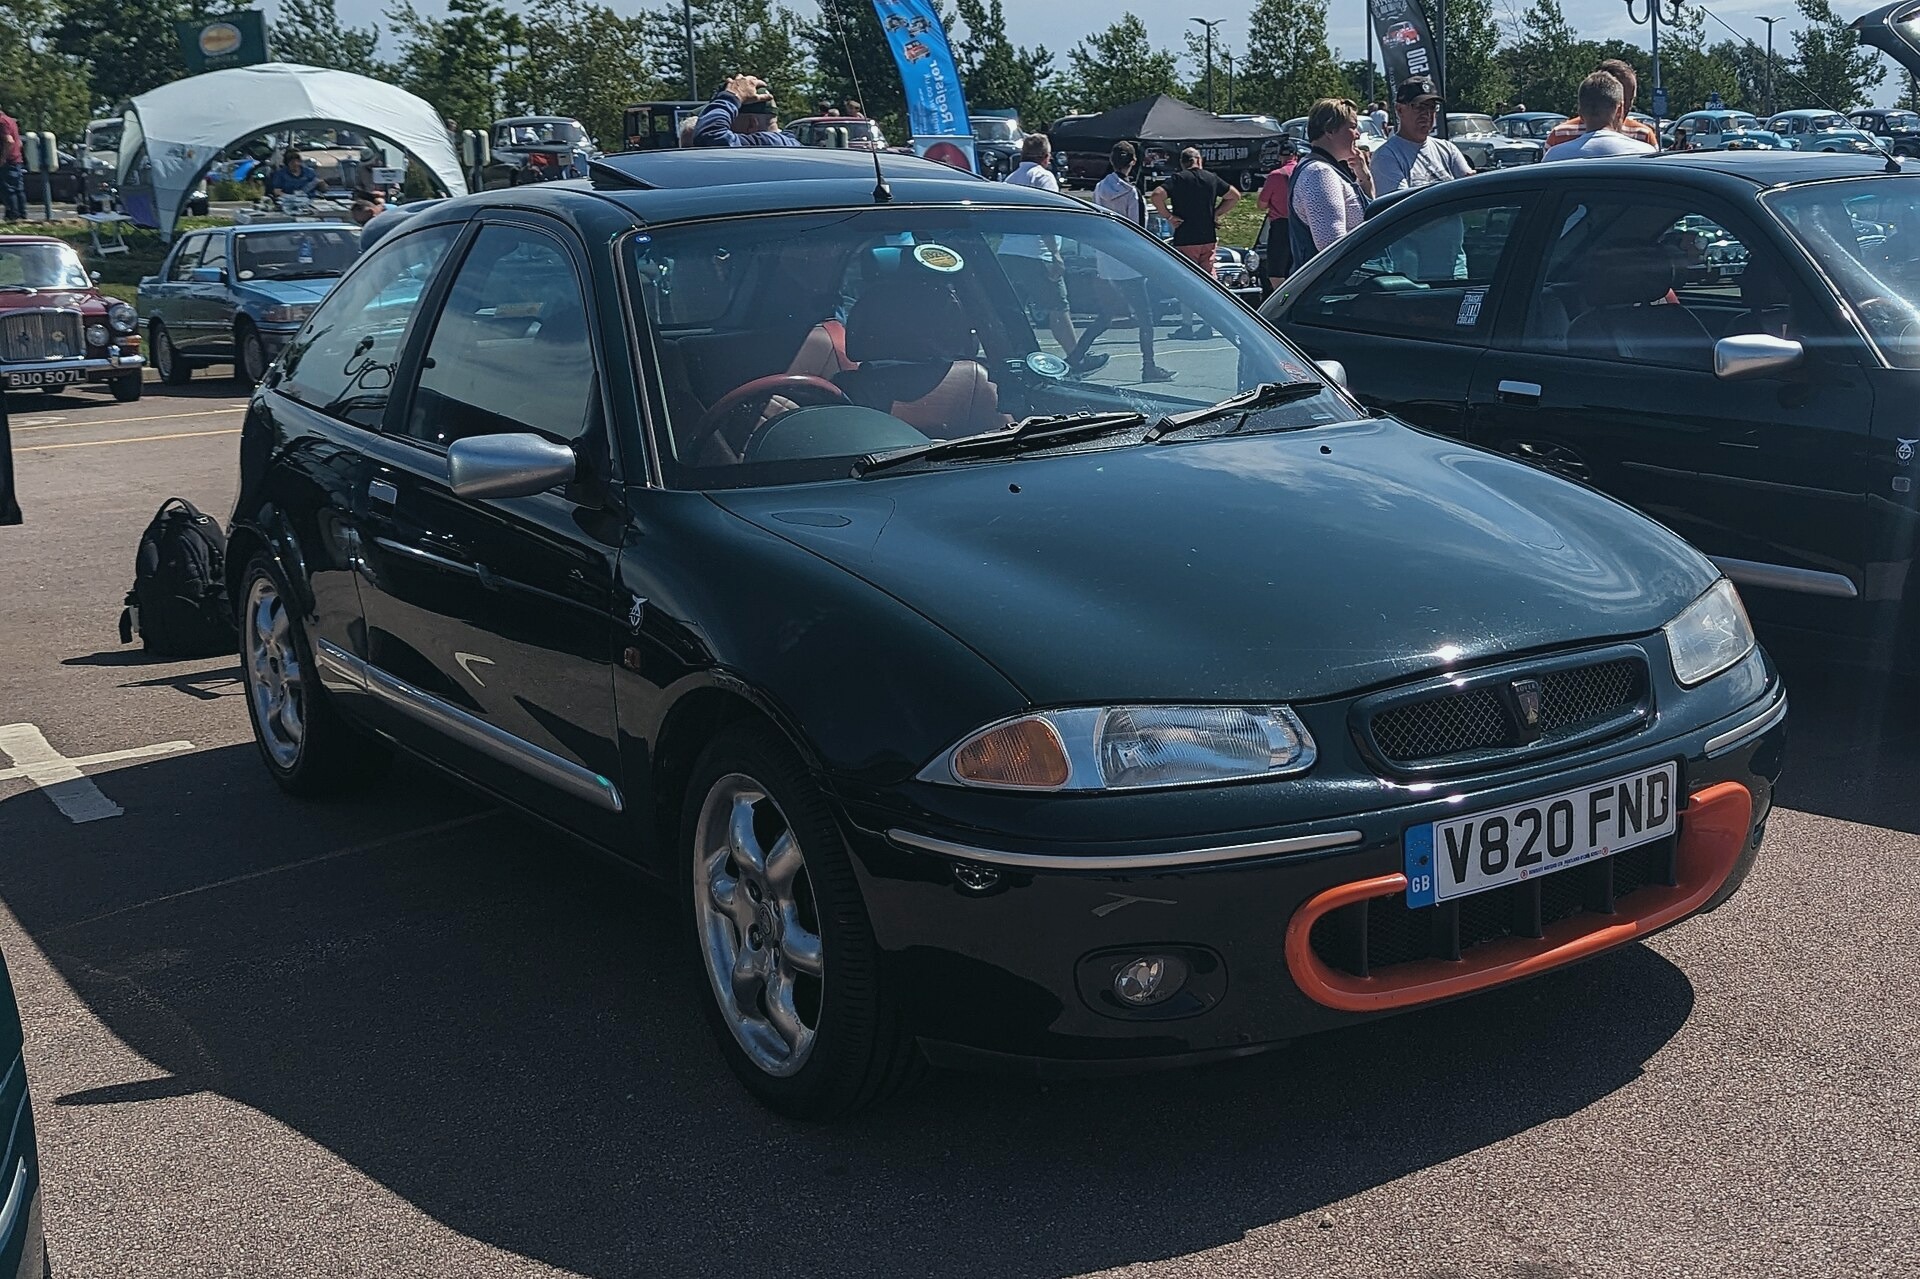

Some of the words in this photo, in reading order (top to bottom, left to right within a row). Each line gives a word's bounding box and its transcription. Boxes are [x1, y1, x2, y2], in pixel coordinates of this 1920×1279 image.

[10, 373, 42, 386] BUO
[45, 370, 86, 383] 507L
[1443, 799, 1574, 885] V820
[1589, 771, 1670, 848] FND
[1411, 874, 1430, 893] GB
